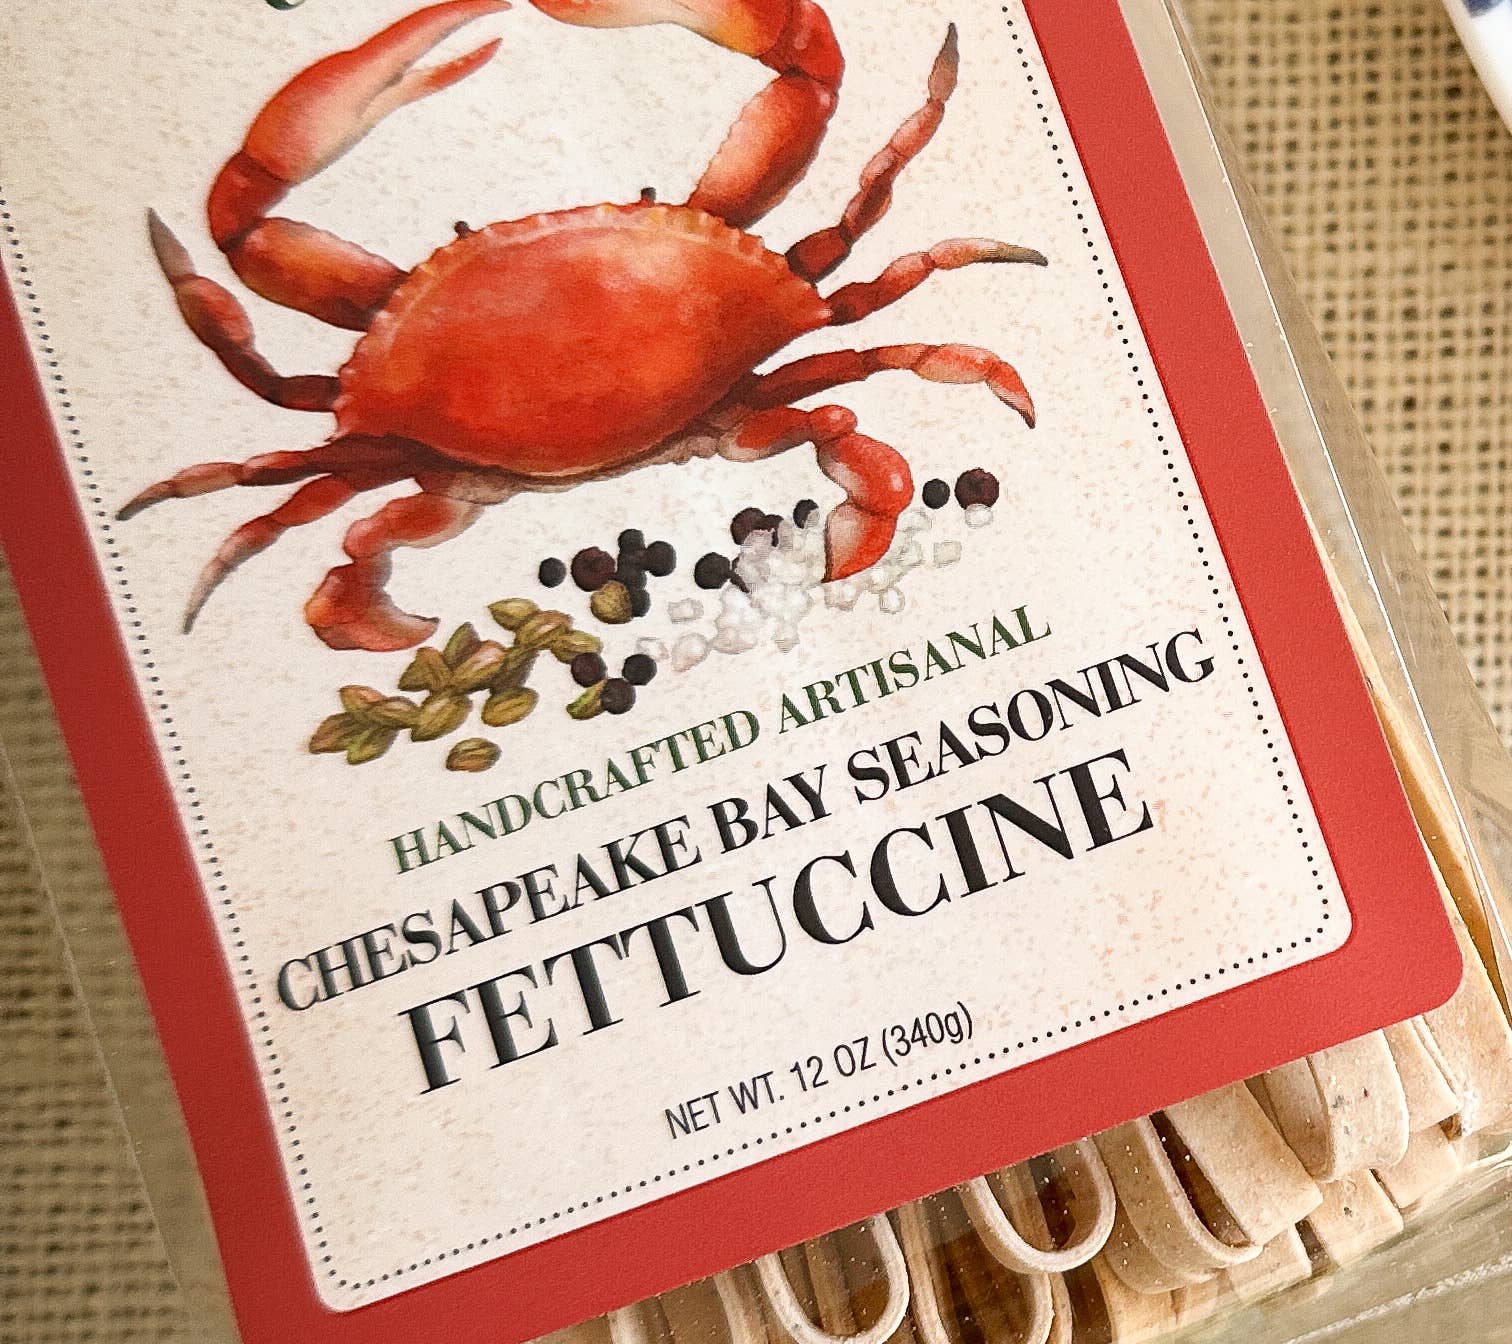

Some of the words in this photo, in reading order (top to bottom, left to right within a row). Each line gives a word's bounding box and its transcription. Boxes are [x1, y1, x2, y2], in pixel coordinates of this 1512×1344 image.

[275, 813, 704, 1015] CHESAPEAKE
[706, 763, 834, 856] BAY
[847, 626, 1217, 805] SEASONING
[387, 708, 762, 876] HANDCRAFTED
[775, 603, 1053, 736] ARTISANAL
[396, 746, 1155, 1097] FETTUCCINE
[664, 1091, 722, 1140] NET
[727, 1070, 785, 1115] WT.
[789, 1055, 829, 1093] 12
[833, 1035, 878, 1079] OZ
[881, 1000, 974, 1067] (340g)
